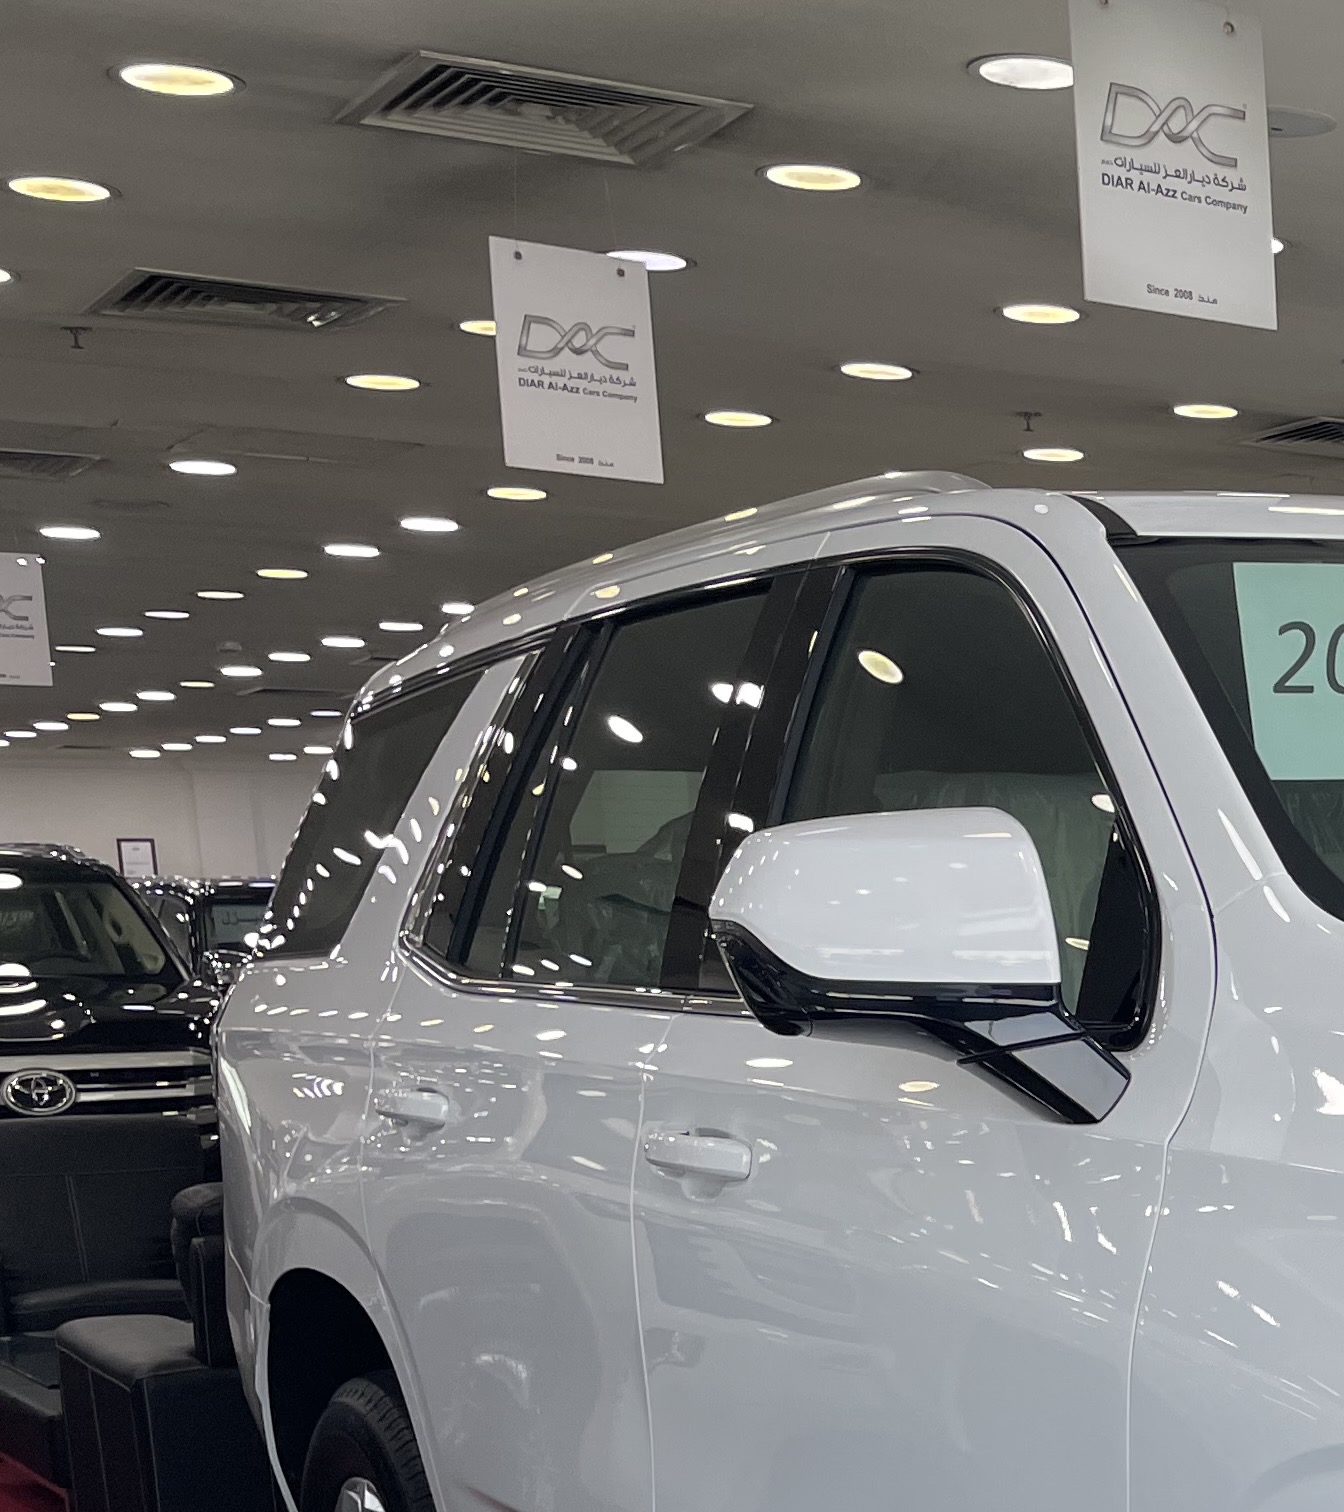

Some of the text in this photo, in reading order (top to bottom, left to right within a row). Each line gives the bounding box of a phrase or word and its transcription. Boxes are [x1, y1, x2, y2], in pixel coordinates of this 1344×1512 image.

[1212, 172, 1247, 192] شركة
[1101, 172, 1249, 215] DIAR Al-Azz Cars Company
[1146, 283, 1170, 297] Since
[517, 376, 545, 390] DIAR
